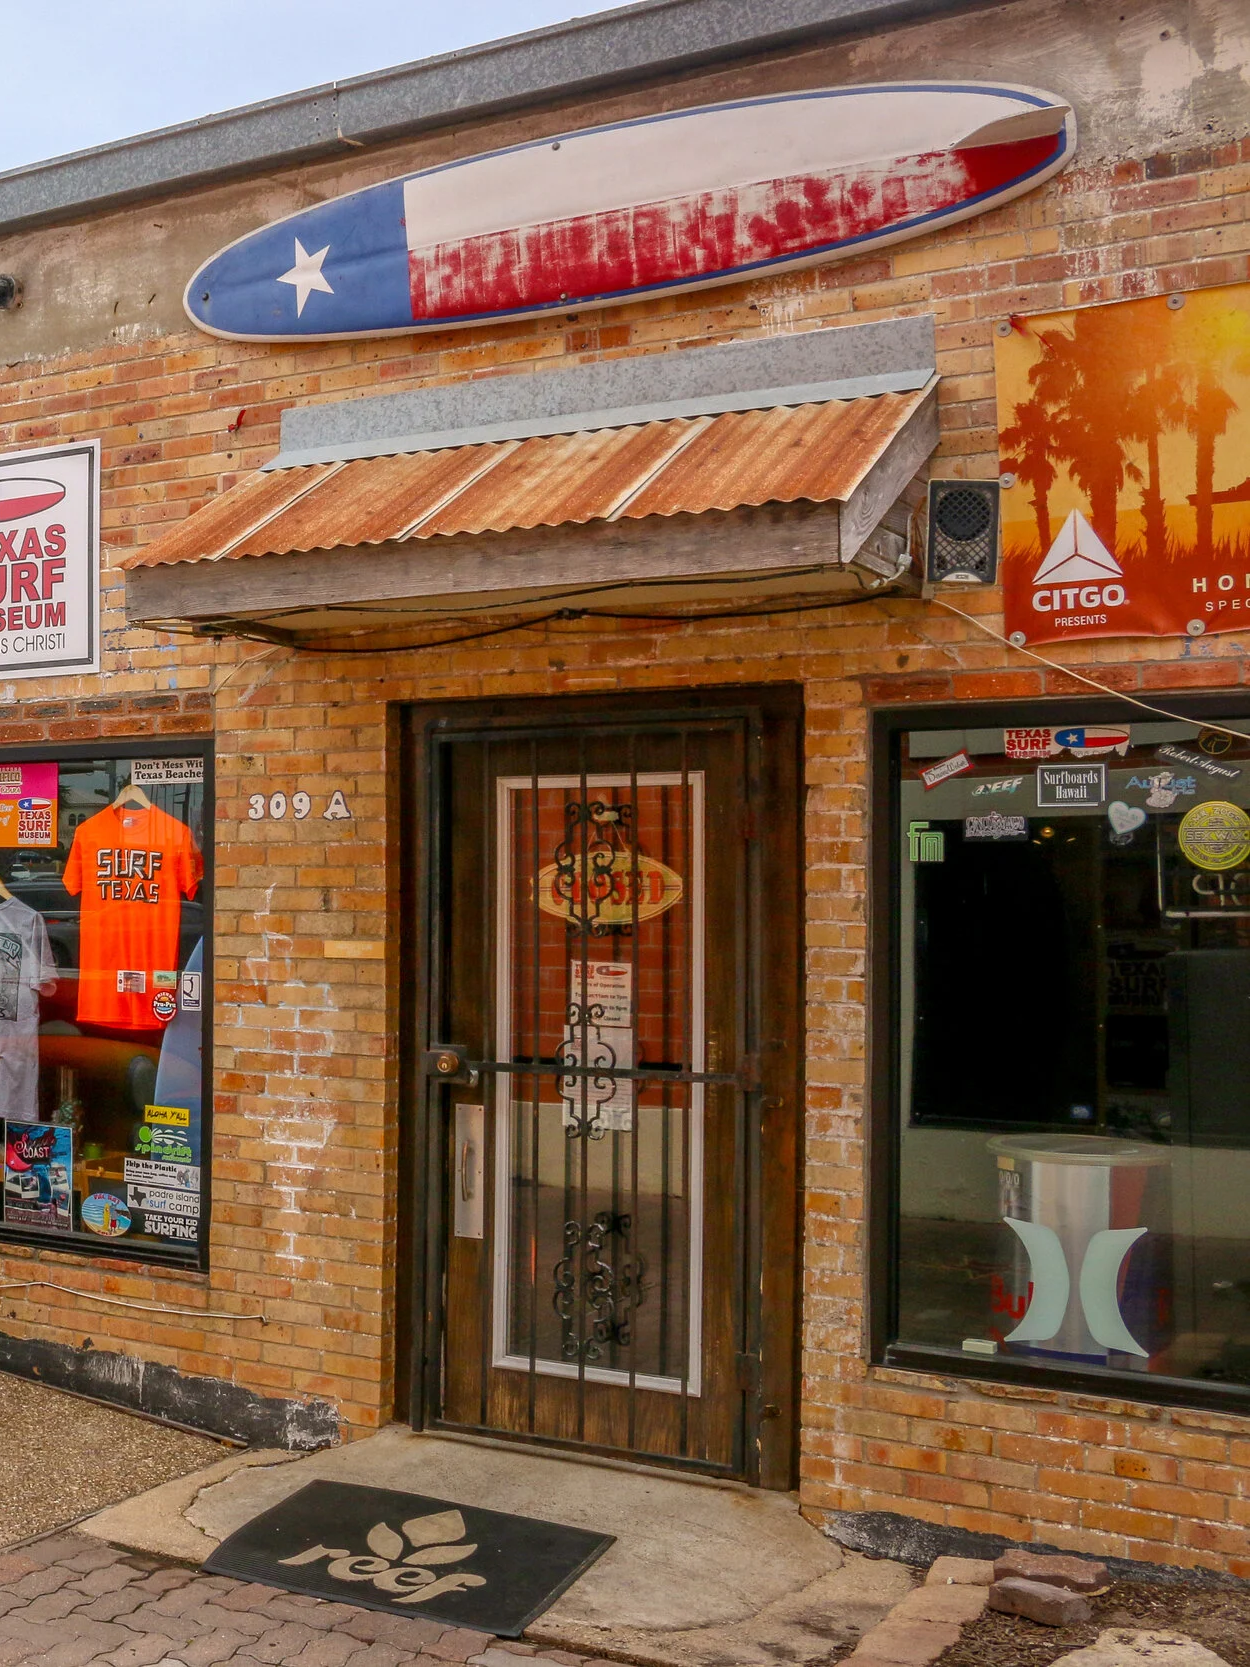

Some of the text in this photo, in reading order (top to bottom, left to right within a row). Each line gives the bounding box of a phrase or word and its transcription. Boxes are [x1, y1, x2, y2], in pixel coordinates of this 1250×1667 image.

[1032, 584, 1125, 612] CITGO
[1054, 614, 1107, 627] PRESENTS
[13, 632, 66, 652] CHRISTI
[1006, 729, 1051, 739] TEXAS
[1006, 739, 1051, 750] SURF
[135, 761, 160, 770] Don't
[162, 760, 184, 769] Mess
[135, 770, 163, 780] Texas
[1044, 770, 1098, 785] Surfboards
[1056, 785, 1087, 799] Hawaii
[248, 790, 352, 821] 309 A
[18, 811, 51, 820] TEXAS
[18, 820, 51, 831] SURF
[18, 831, 51, 839] MUSEUM
[97, 848, 162, 881] SURF
[97, 880, 160, 903] TEXAS
[147, 1109, 167, 1119] ALOHA
[23, 1146, 50, 1158] COAST
[126, 1160, 141, 1169] Skip
[154, 1163, 177, 1173] Plastic
[149, 1190, 200, 1204] padre island
[149, 1199, 199, 1215] surf camp
[144, 1213, 198, 1227] TAKE YOUR KID
[144, 1221, 198, 1239] SURFING
[278, 1543, 487, 1603] reef
